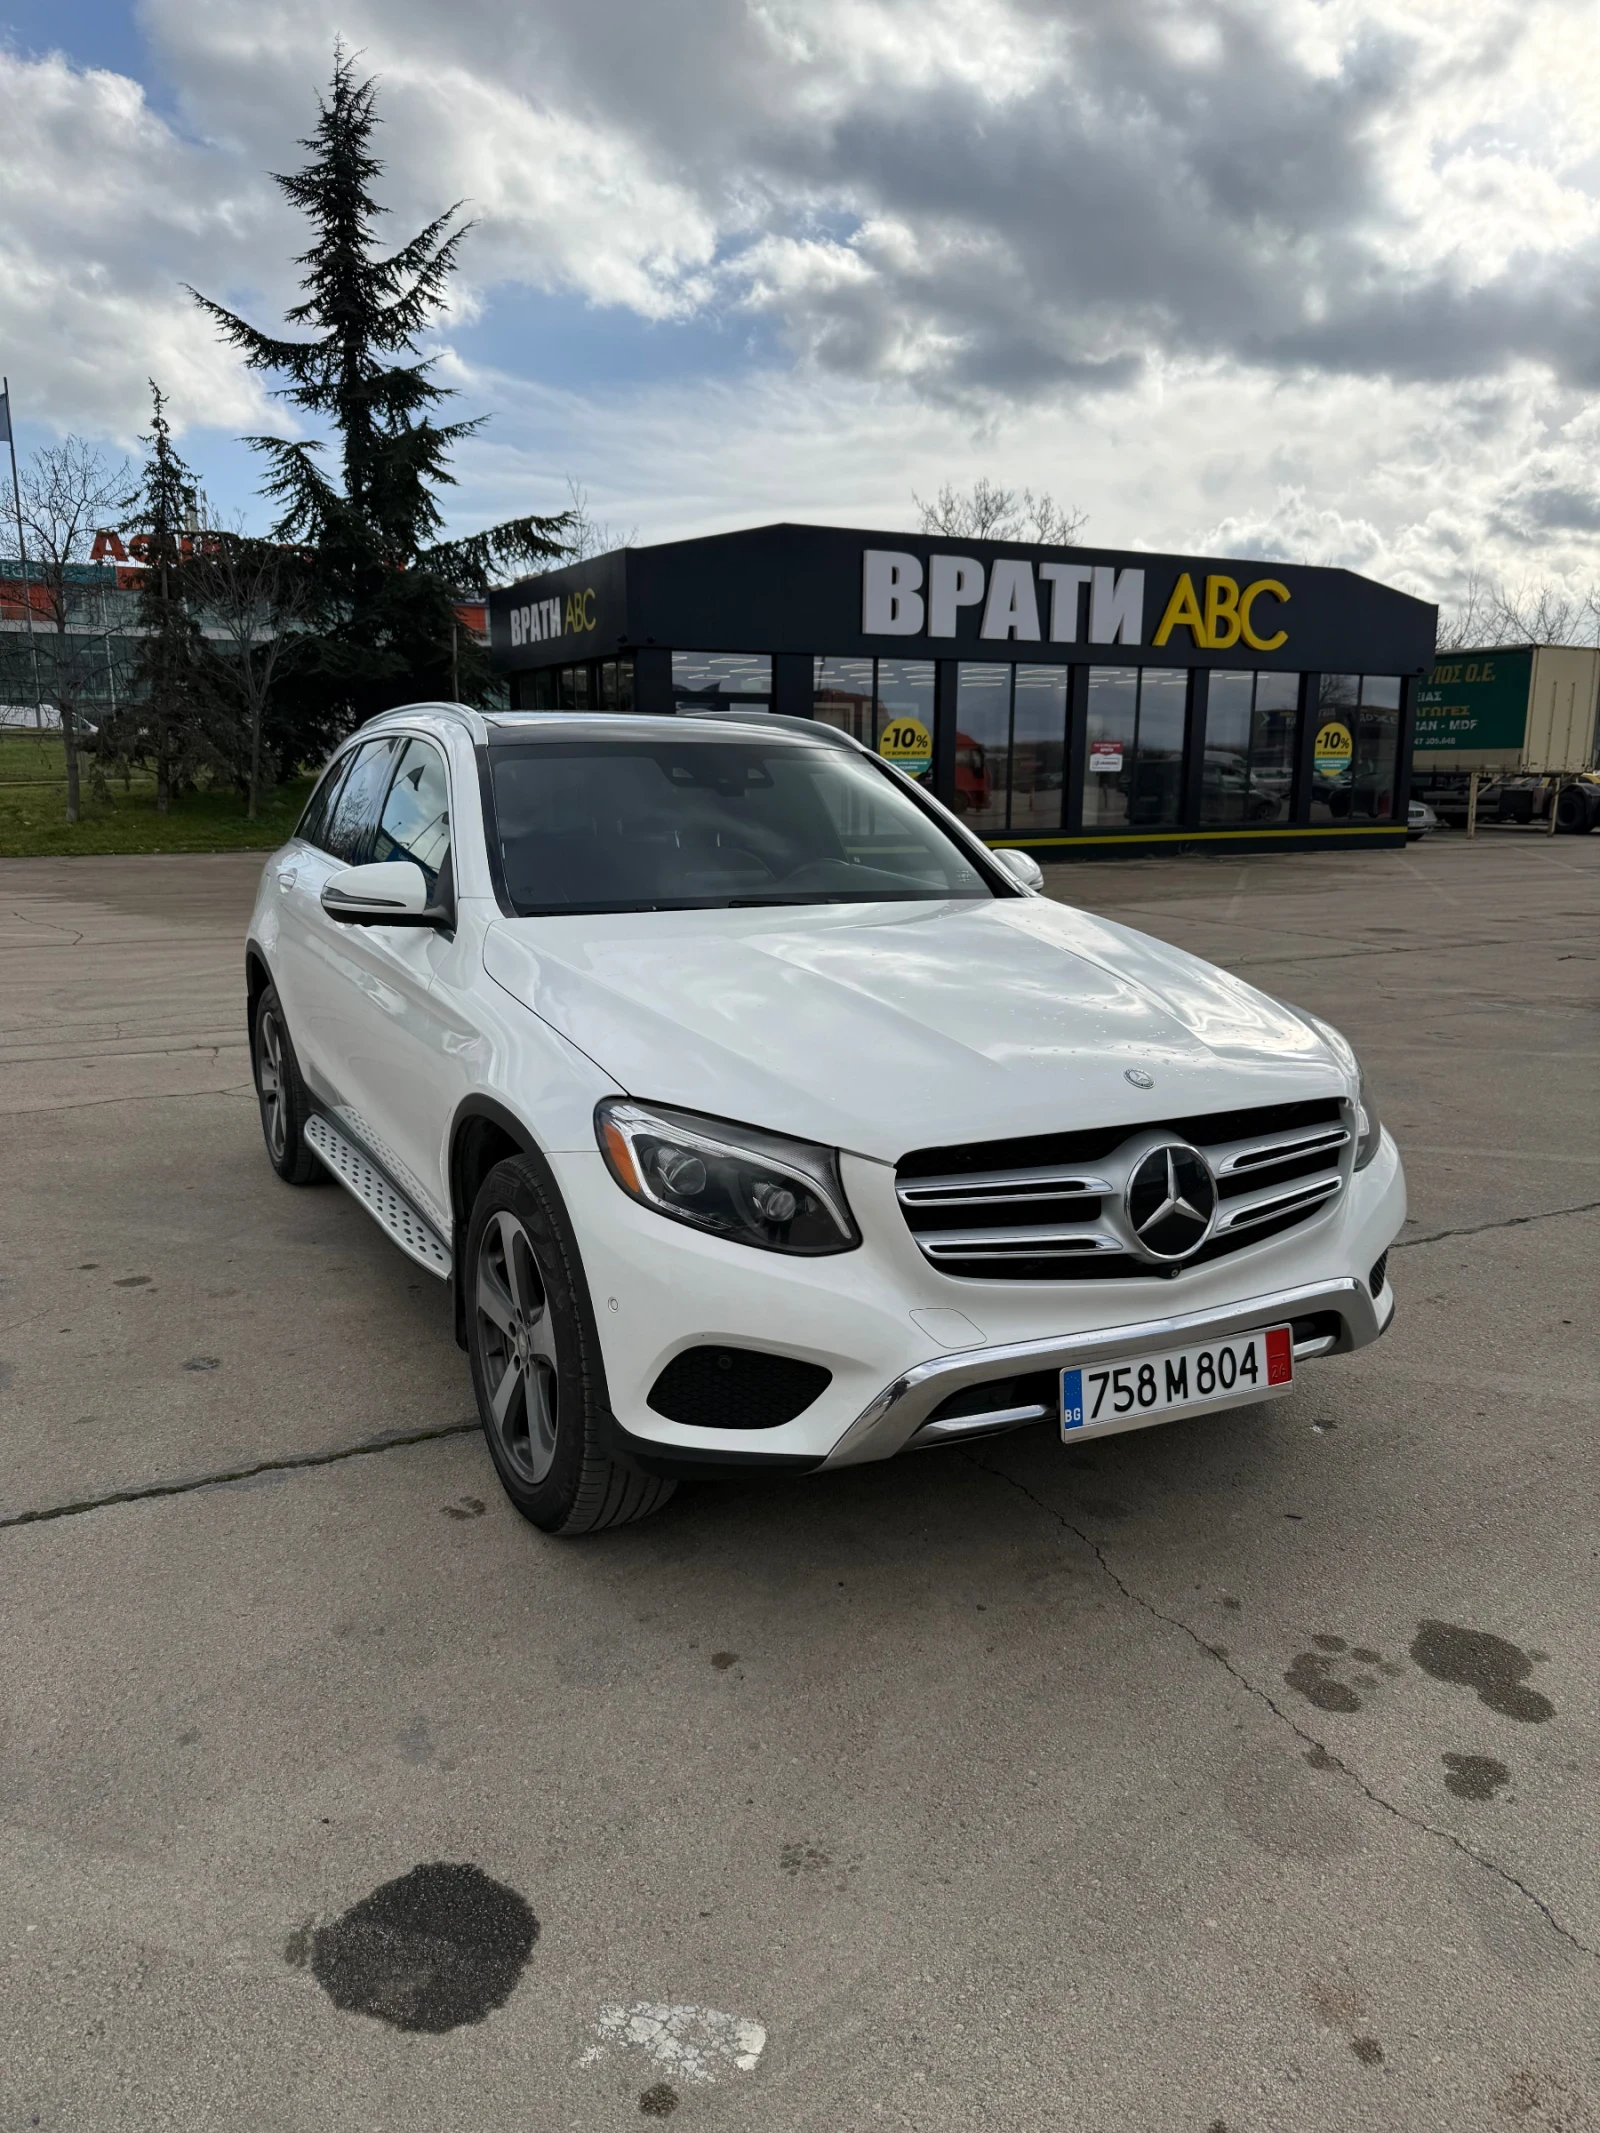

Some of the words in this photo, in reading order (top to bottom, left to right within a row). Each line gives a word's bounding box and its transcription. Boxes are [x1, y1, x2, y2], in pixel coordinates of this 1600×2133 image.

[862, 549, 1145, 645] ВРАТИ
[1152, 573, 1292, 651] ABC
[510, 597, 561, 647] ВРАТИ
[564, 588, 596, 635] ABC
[883, 727, 928, 748] -10%
[1317, 731, 1350, 749] -10%
[1088, 1363, 1157, 1419] 758
[1164, 1356, 1189, 1403] M
[1196, 1341, 1259, 1394] 804
[1272, 1363, 1286, 1379] 26
[1065, 1408, 1081, 1423] BG
